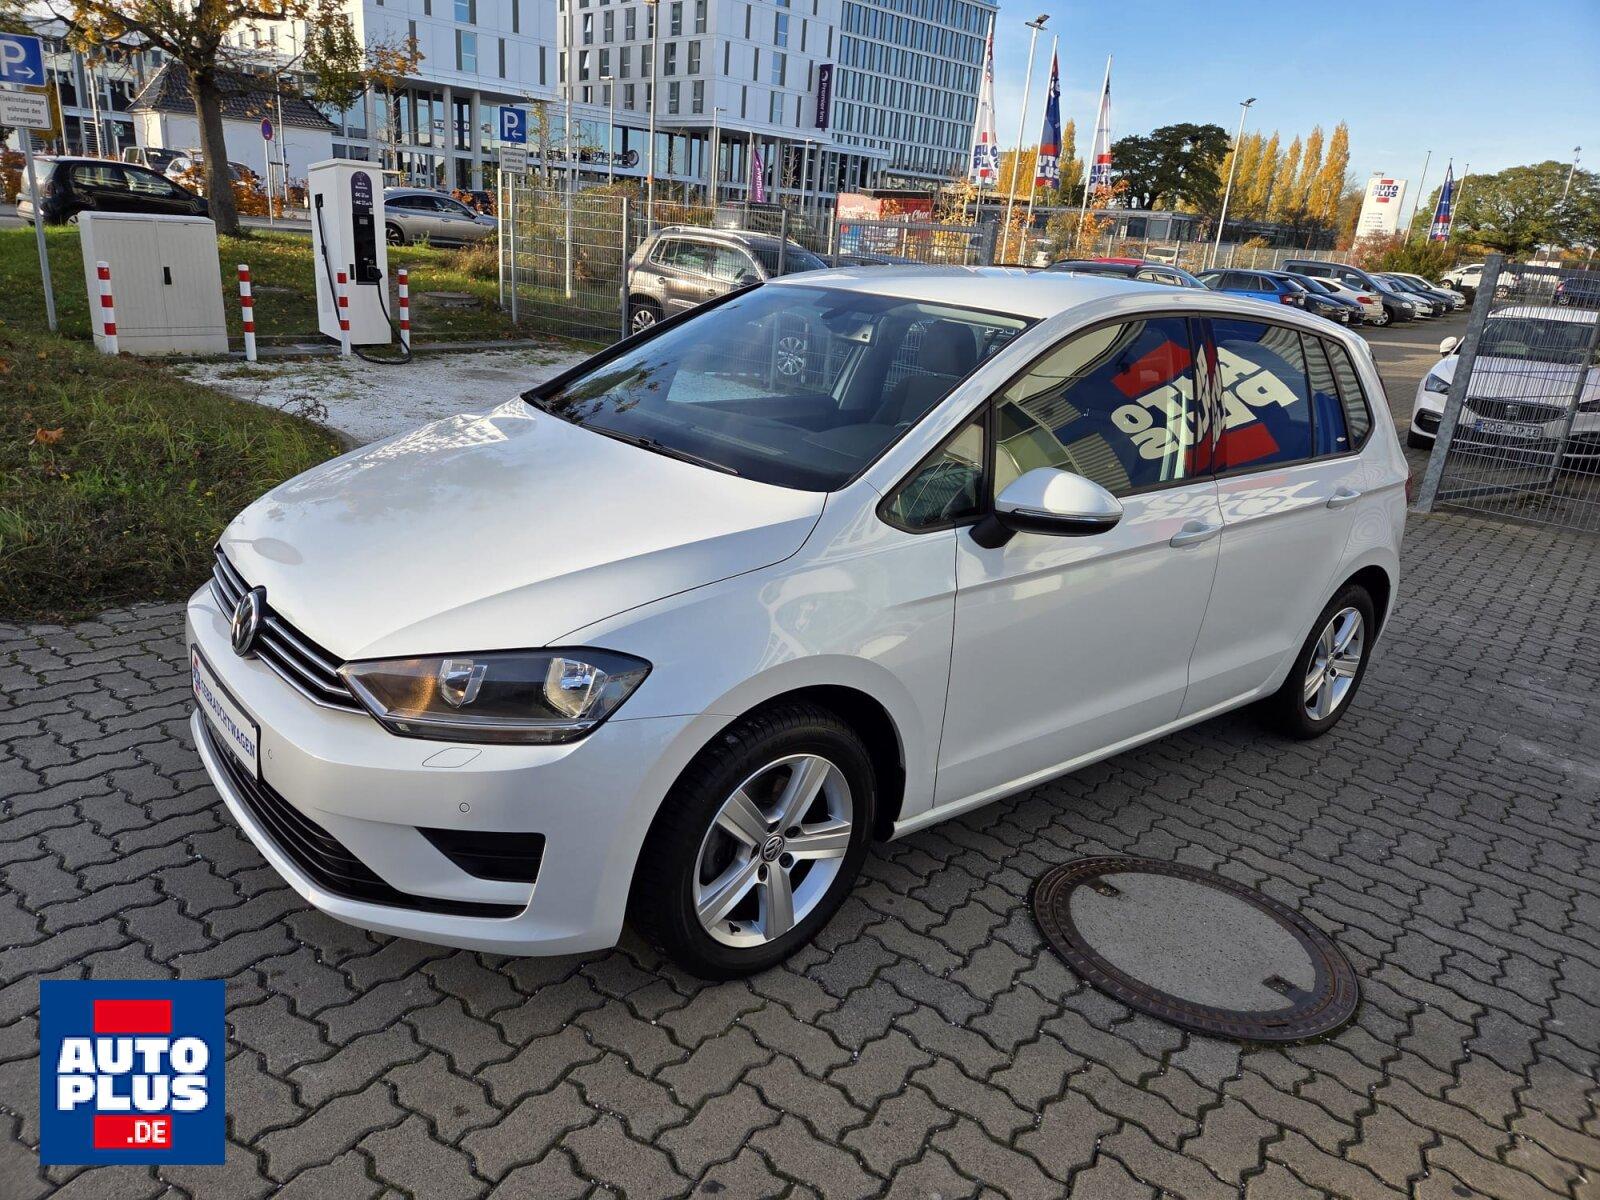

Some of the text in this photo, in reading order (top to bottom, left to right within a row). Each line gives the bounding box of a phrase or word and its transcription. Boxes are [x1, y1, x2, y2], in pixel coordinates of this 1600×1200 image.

[974, 145, 998, 157] AUO
[1038, 155, 1060, 168] UTO
[1036, 166, 1060, 179] LUS
[1372, 190, 1398, 198] PLUS
[201, 680, 256, 759] GEBRAUCHTWAGEN
